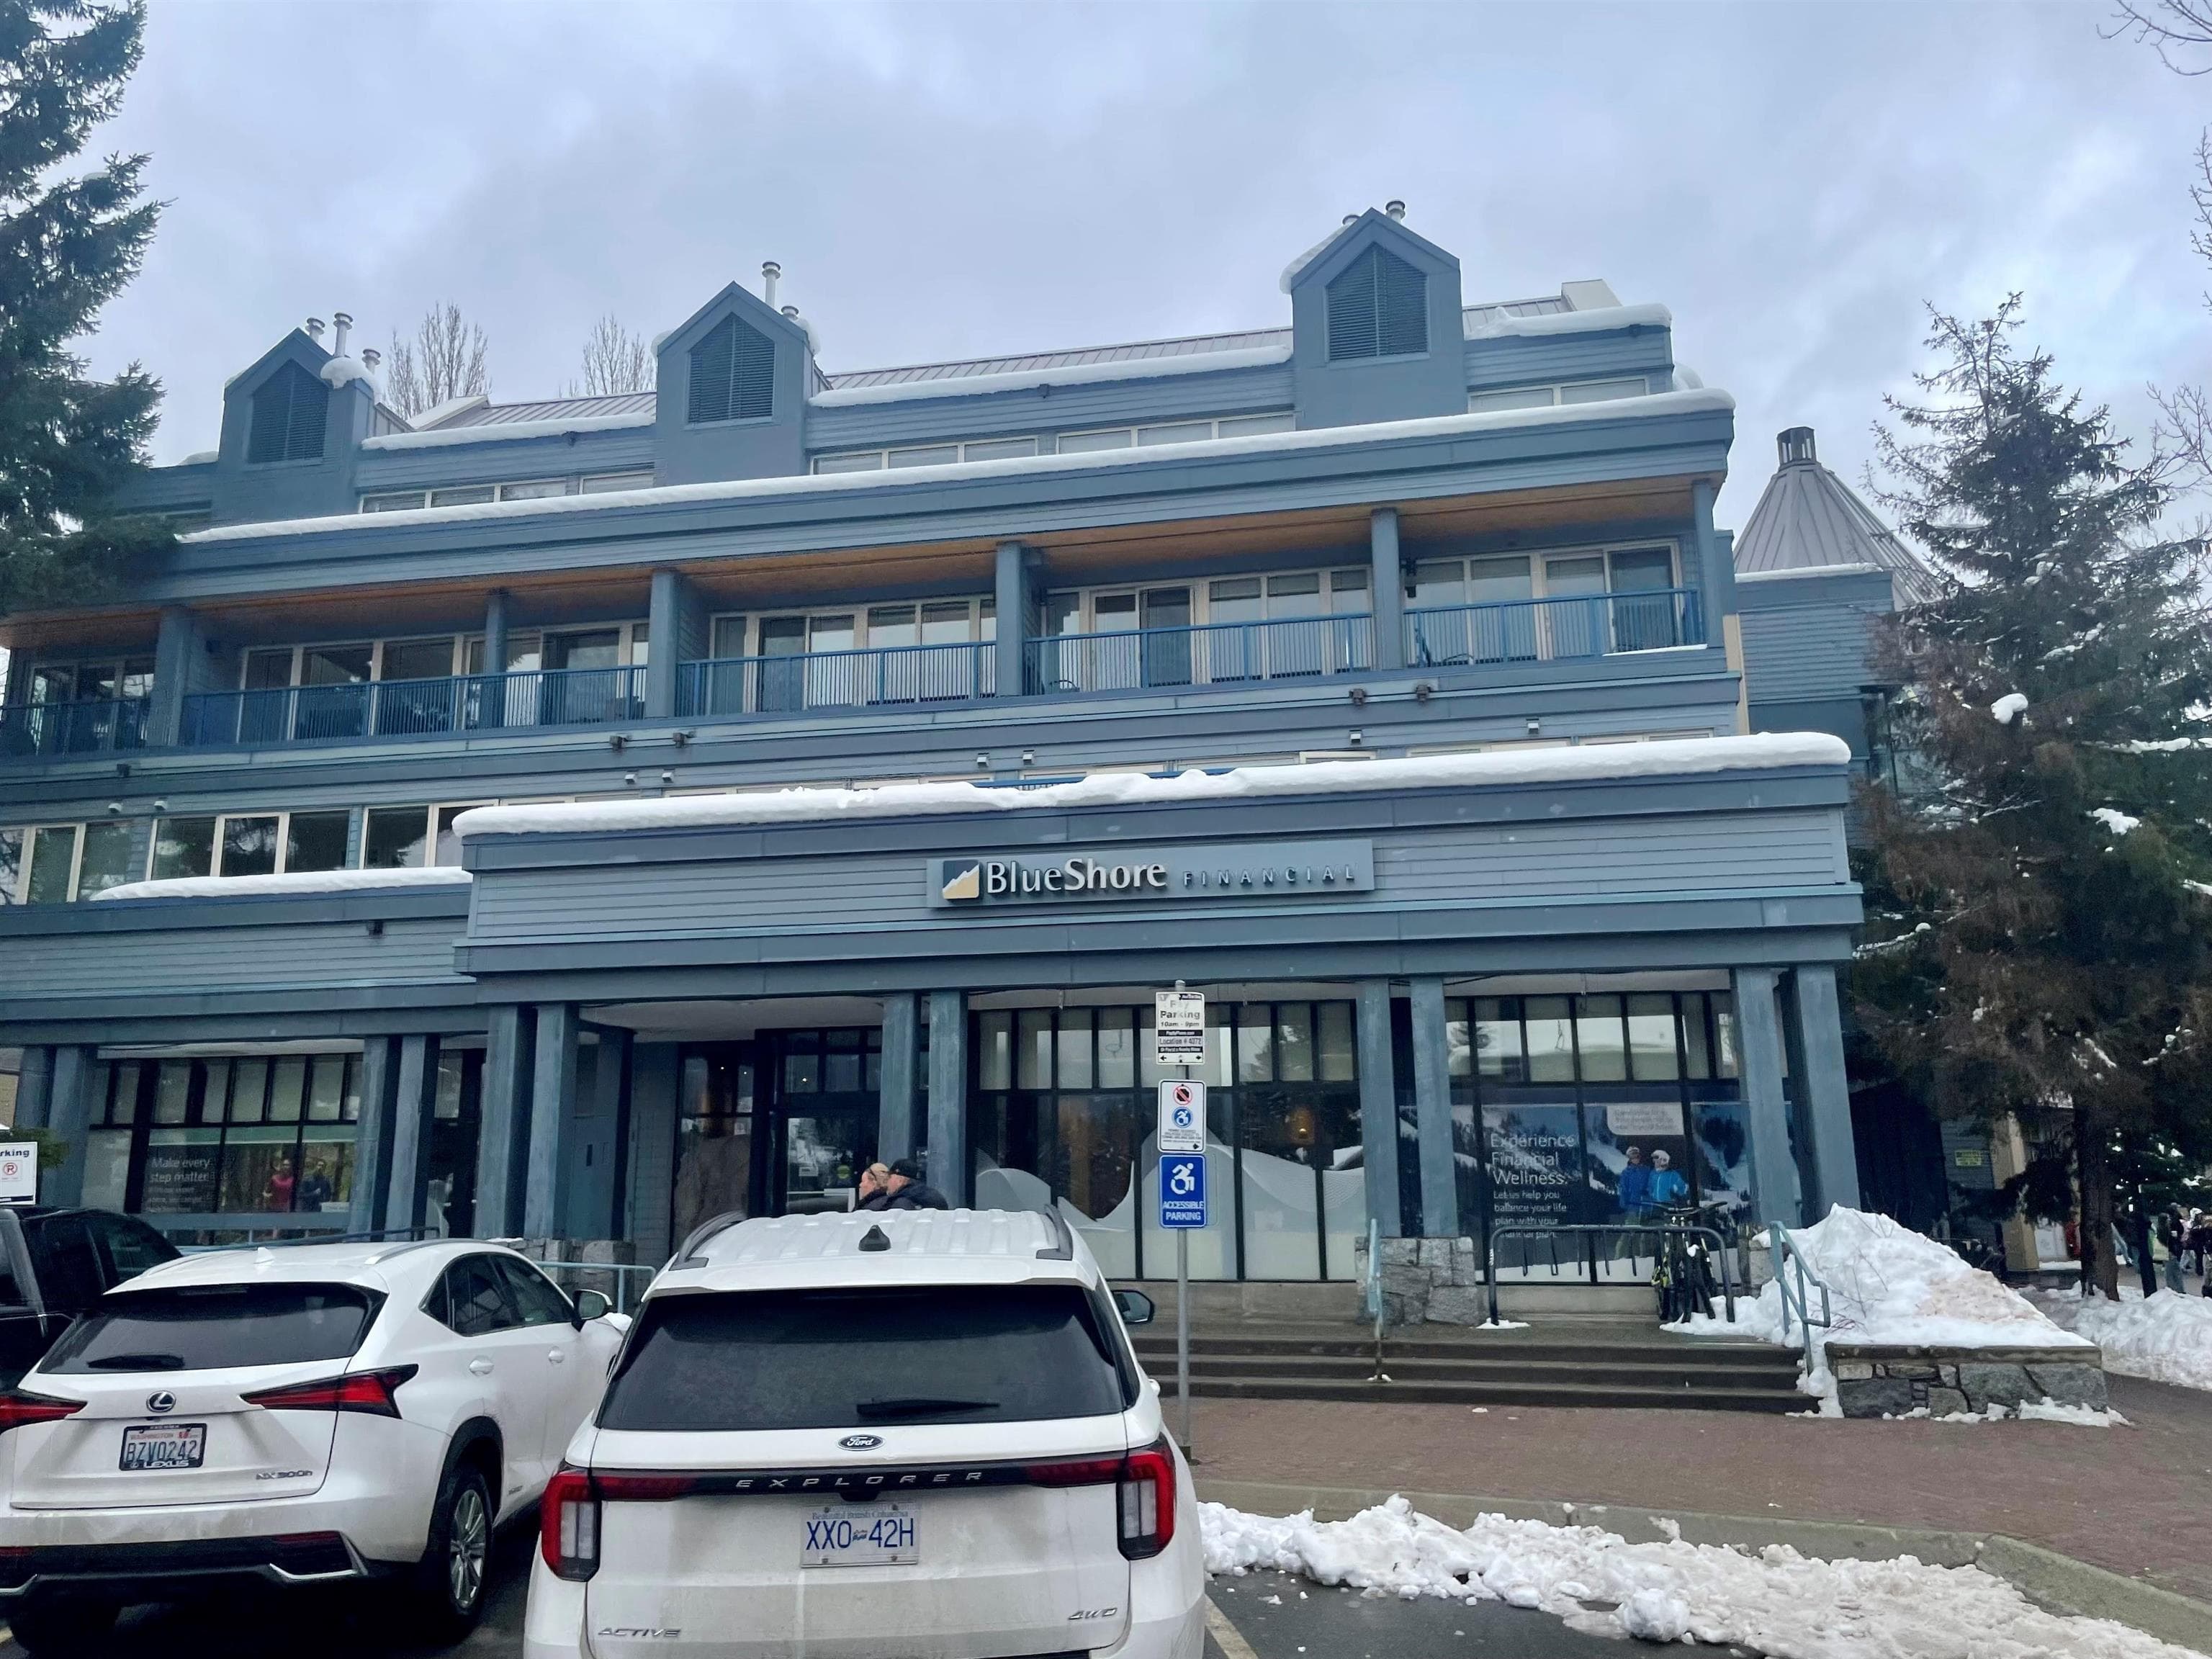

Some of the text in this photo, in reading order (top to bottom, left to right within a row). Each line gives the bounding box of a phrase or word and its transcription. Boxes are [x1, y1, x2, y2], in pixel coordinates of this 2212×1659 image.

[986, 857, 1355, 894] BlueShore FINANCIAL
[1491, 1133, 1575, 1150] Experience
[0, 1149, 30, 1158] rking
[1492, 1151, 1558, 1166] Financial
[1493, 1169, 1568, 1184] Wellness.
[1166, 1211, 1202, 1220] PARKING
[847, 1437, 874, 1447] Ford
[144, 1459, 189, 1469] LEXUS
[735, 1472, 982, 1488] EXPLORER
[598, 1627, 681, 1637] ACTIVE
